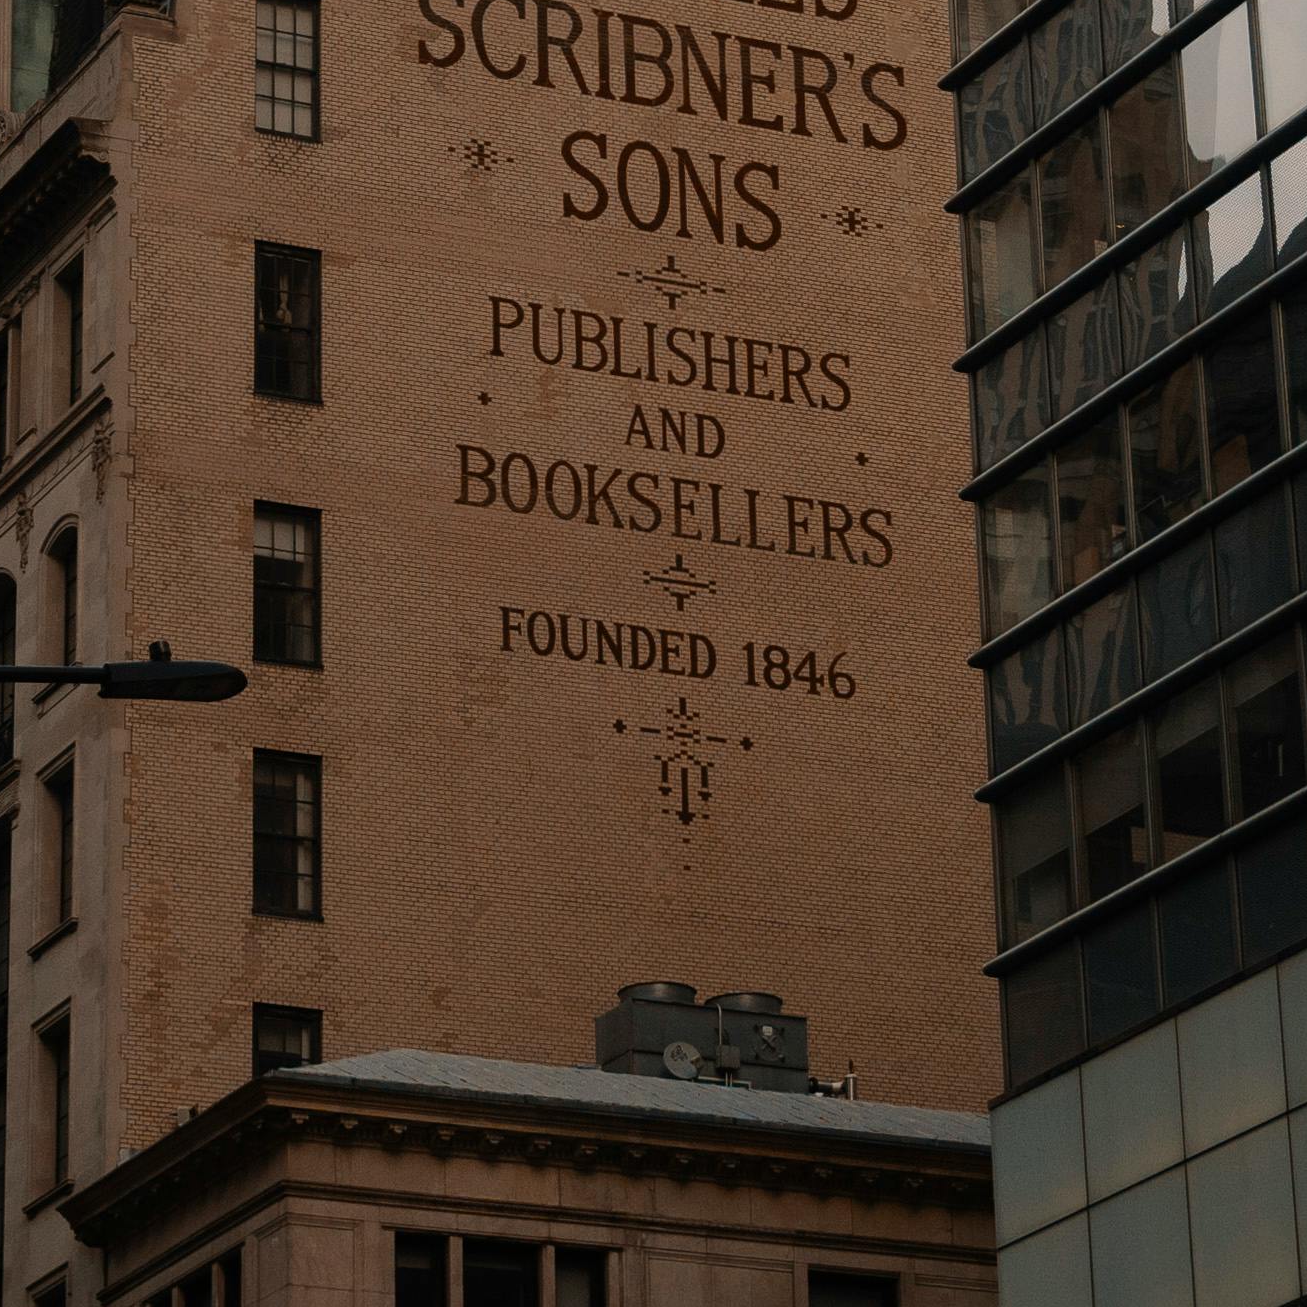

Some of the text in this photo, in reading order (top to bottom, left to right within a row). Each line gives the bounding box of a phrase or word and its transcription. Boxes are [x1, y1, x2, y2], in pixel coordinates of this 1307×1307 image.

[561, 131, 782, 252] SONS
[489, 295, 851, 412] PUBLISHERS
[624, 404, 726, 459] AND
[454, 443, 893, 569] BOOKSELLERS
[498, 605, 857, 700] FOUNDED 1846
